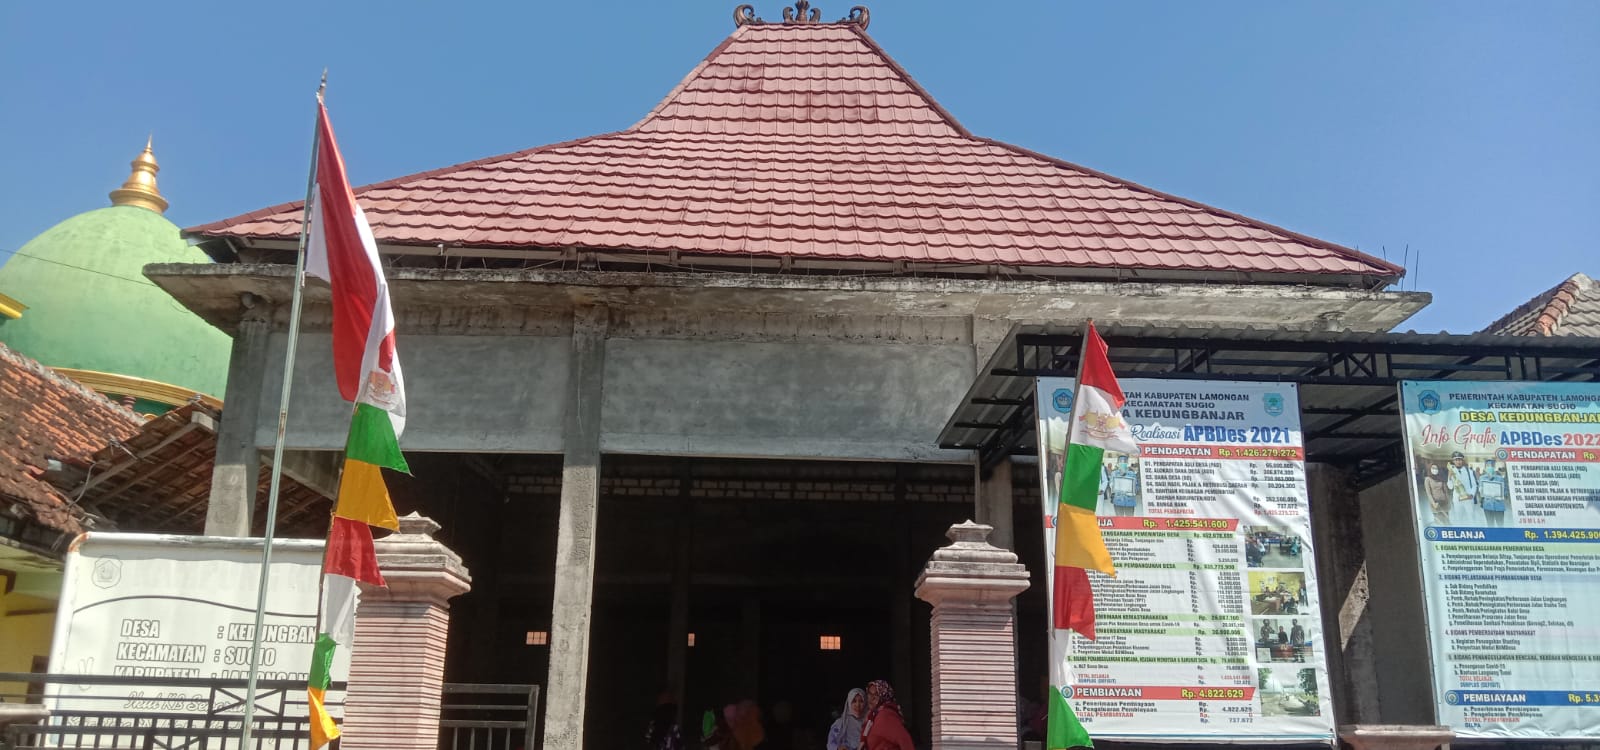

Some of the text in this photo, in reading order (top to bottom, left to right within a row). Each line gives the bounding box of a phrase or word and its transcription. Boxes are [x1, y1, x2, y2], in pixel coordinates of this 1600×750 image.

[1144, 392, 1196, 400] KABUPATEN
[1200, 393, 1249, 402] LAMONGAN
[1125, 400, 1182, 408] KECAMATAN
[1136, 409, 1245, 421] KEDUNGBANJAR
[1460, 411, 1495, 422] DESA
[1184, 425, 1247, 442] APBDes
[1250, 426, 1290, 444] 2021
[1422, 424, 1450, 448] Info
[1453, 424, 1497, 449] Grafis
[1500, 431, 1563, 446] APBDes
[1145, 447, 1211, 456] PENDAPATAN
[1218, 448, 1233, 460] Rp.
[1511, 451, 1597, 461] PENDAPATAN Rp.
[1144, 520, 1158, 529] Rp.
[1442, 530, 1600, 541] BELANJA Rp. 1.394.425.90
[121, 619, 160, 638] DESA
[116, 643, 206, 663] KECAMATAN
[1077, 688, 1244, 700] PEMBIAYAAN Rp. 4.822.629
[1463, 694, 1600, 704] PEMBIAYAAN Rp. 5.3
